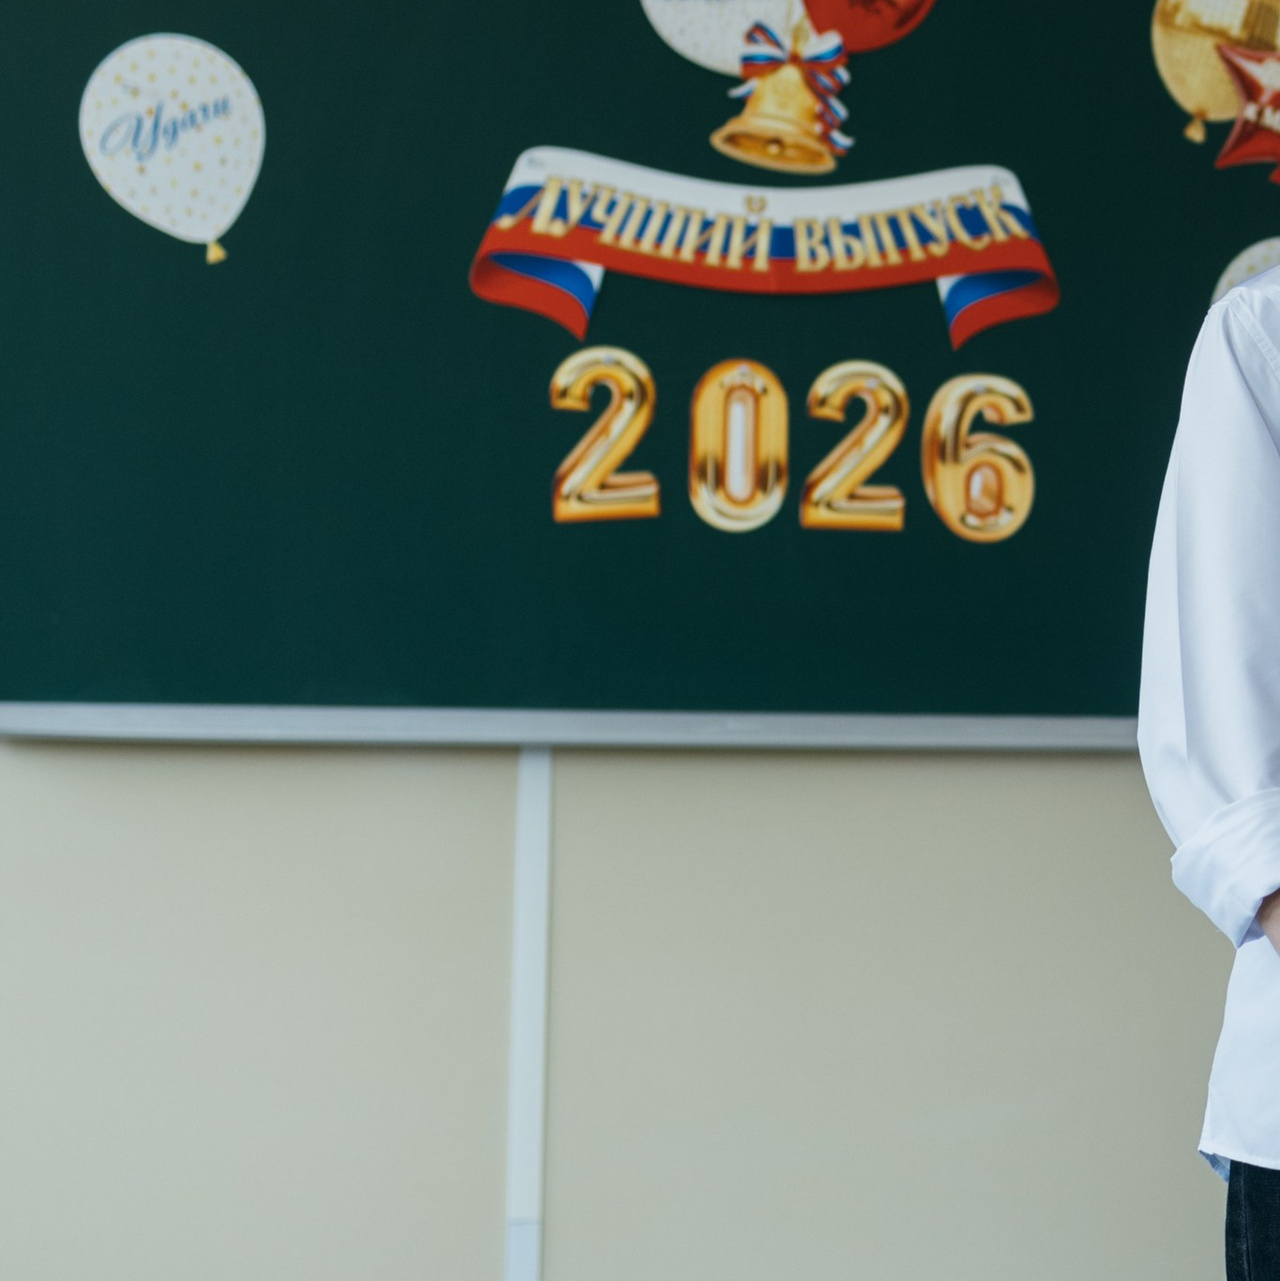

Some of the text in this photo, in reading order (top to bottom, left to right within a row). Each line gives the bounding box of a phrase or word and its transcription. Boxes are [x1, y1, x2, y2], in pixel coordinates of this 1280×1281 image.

[499, 176, 1032, 273] ЛУЧШИЙ ВЫПУСК
[550, 345, 1036, 543] 2026
